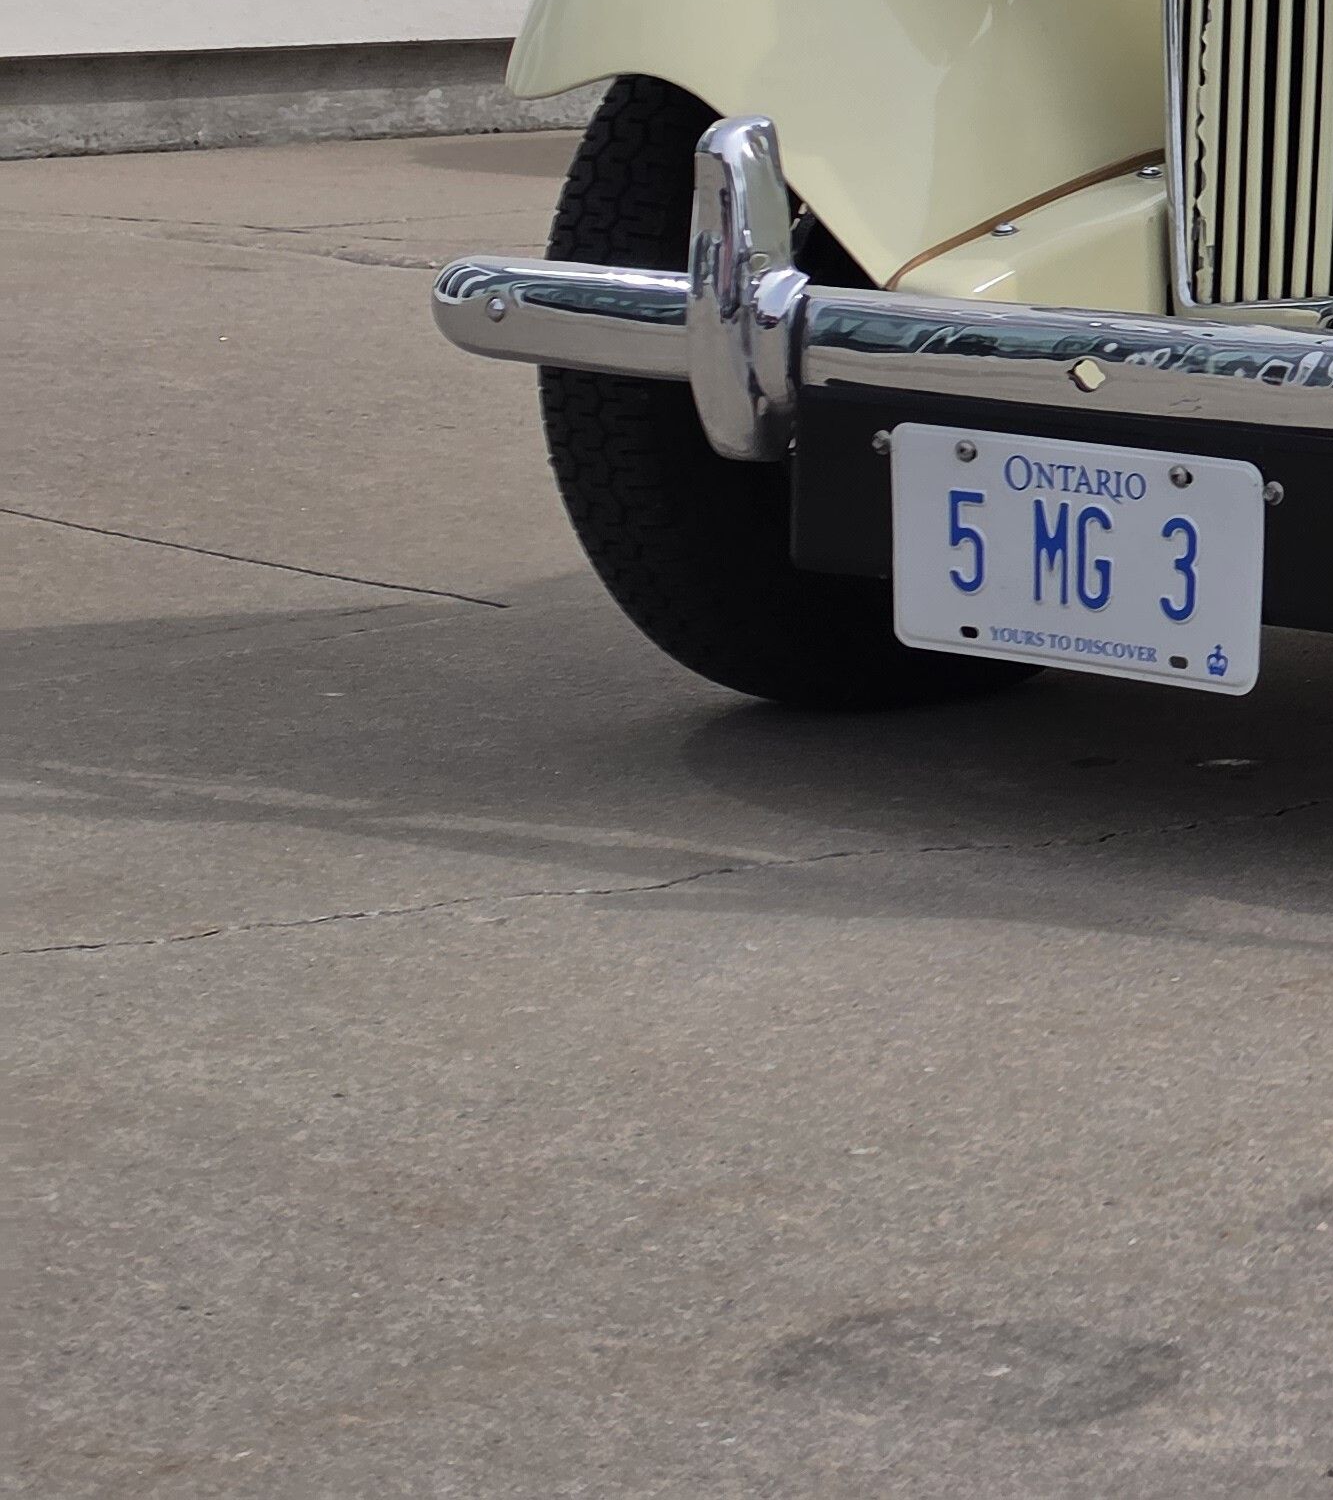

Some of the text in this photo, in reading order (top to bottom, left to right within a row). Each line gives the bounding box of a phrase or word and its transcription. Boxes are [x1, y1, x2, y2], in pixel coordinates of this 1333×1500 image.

[949, 489, 1198, 621] 5 MG 3
[989, 625, 1157, 664] YOURS TO DISCOVER
